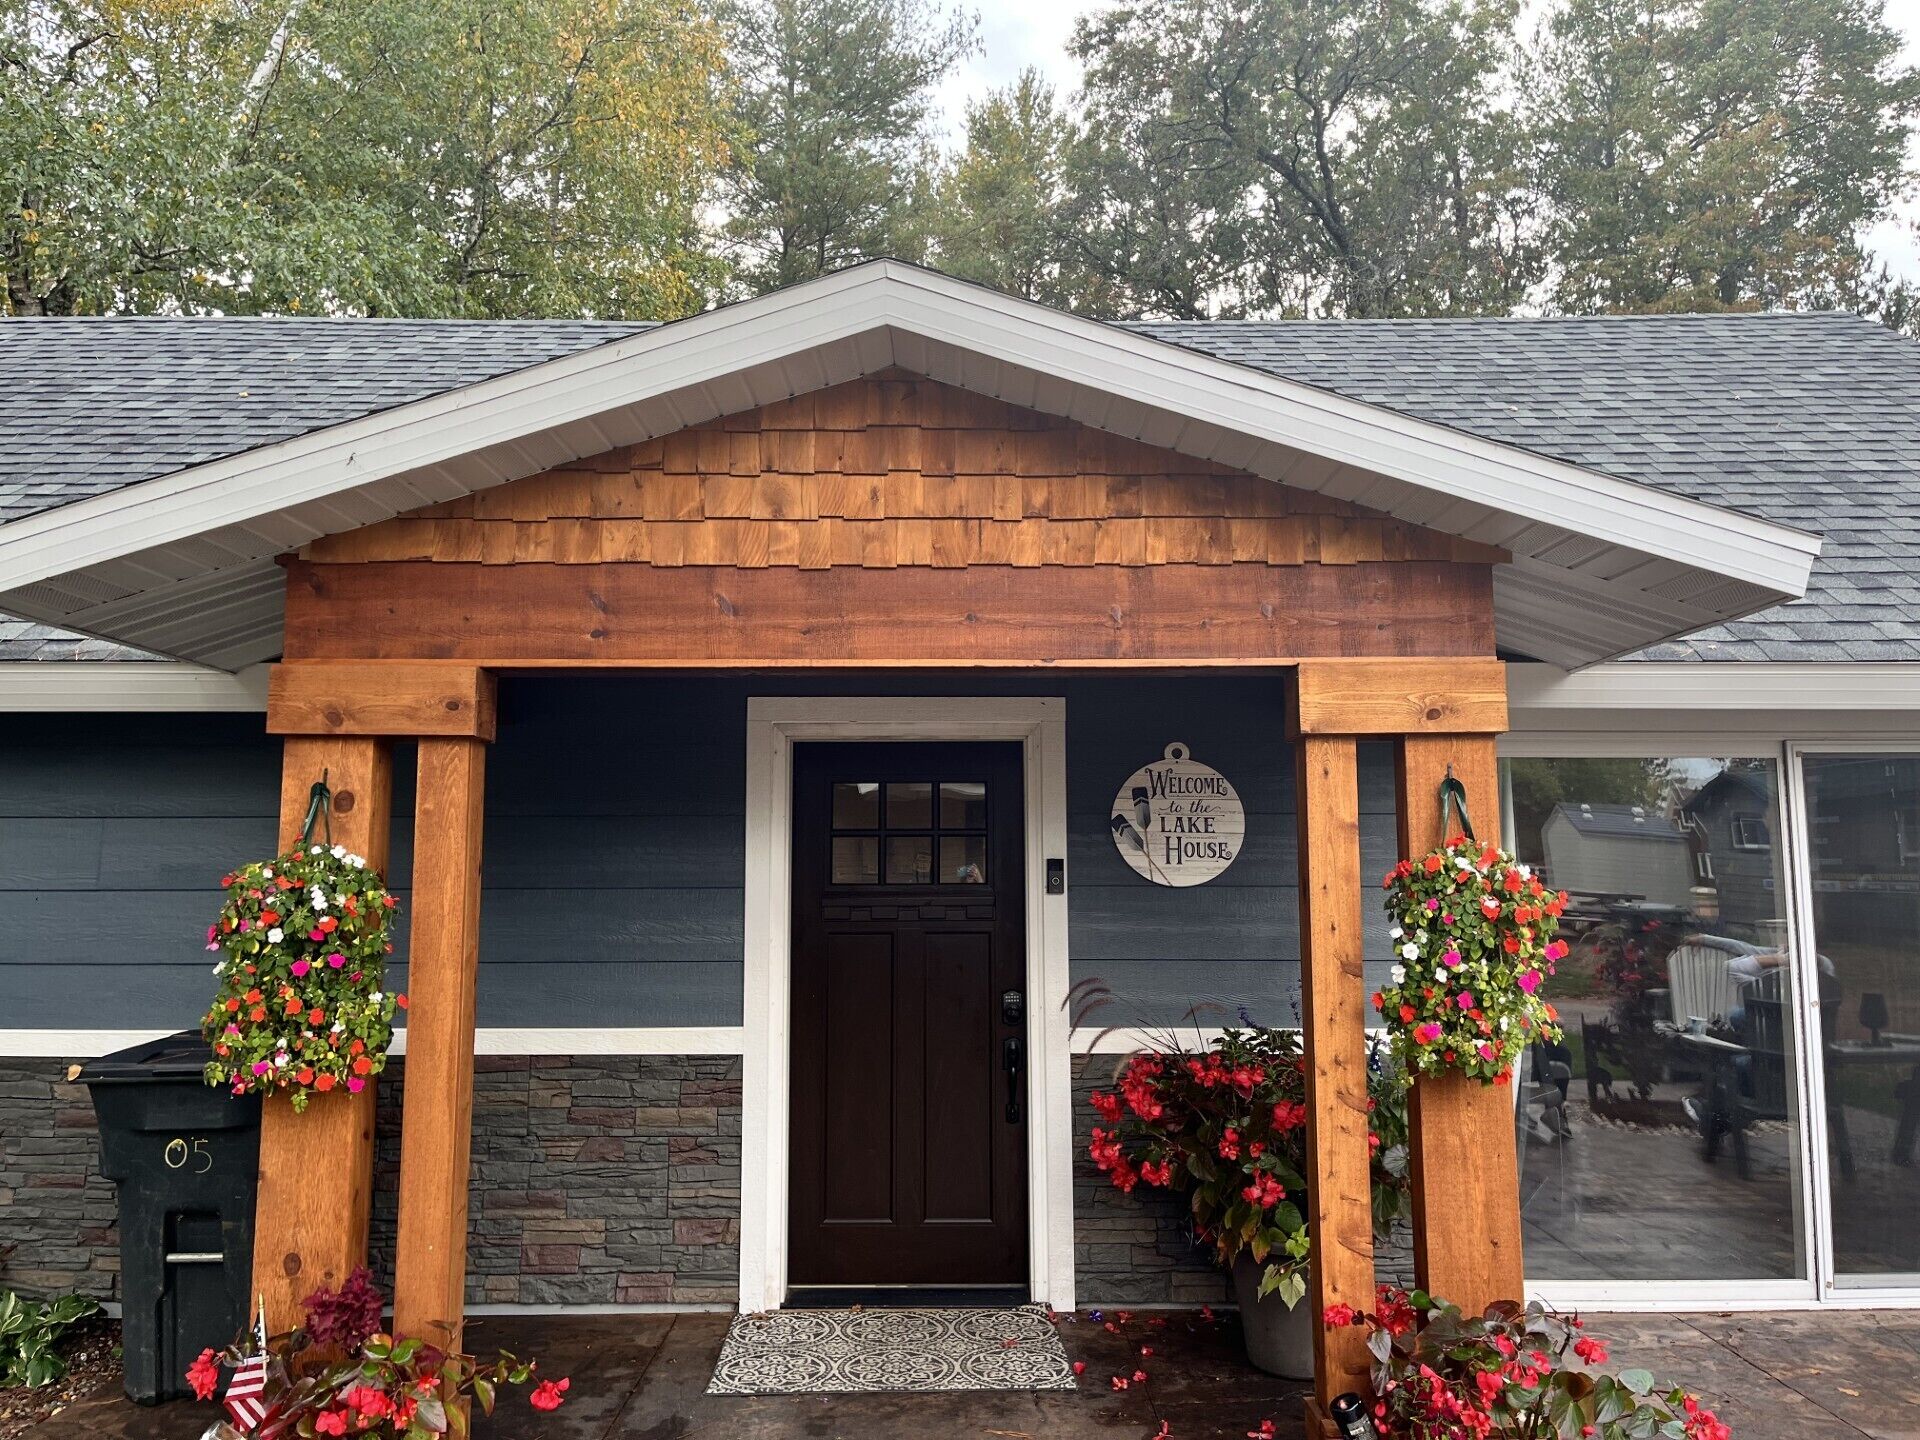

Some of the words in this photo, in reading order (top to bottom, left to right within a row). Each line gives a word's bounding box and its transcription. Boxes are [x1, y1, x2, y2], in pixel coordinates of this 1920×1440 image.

[1144, 767, 1228, 799] WELCOME
[1161, 800, 1182, 813] to
[1189, 799, 1220, 813] the
[1160, 816, 1216, 833] LAKE
[1164, 835, 1232, 865] HOUSE
[165, 1137, 212, 1174] 05
